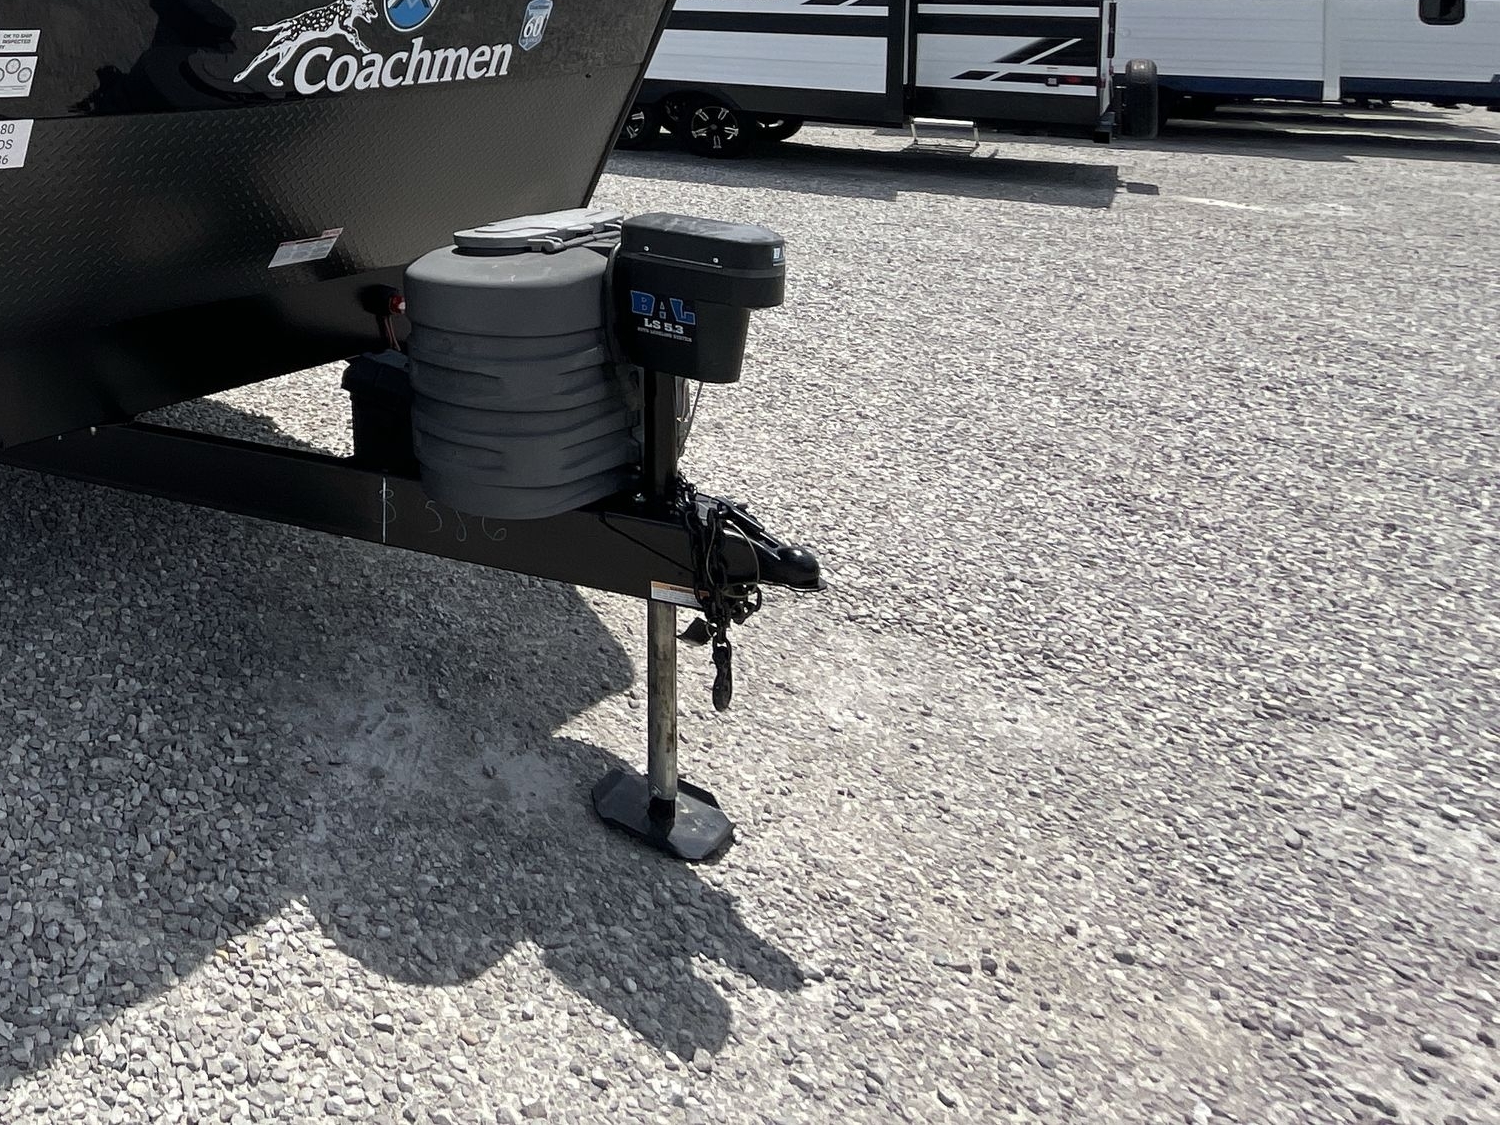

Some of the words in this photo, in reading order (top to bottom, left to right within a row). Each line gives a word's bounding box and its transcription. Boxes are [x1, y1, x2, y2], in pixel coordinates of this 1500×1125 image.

[523, 15, 544, 38] 60
[294, 36, 513, 95] Coachmen
[644, 318, 661, 330] LS
